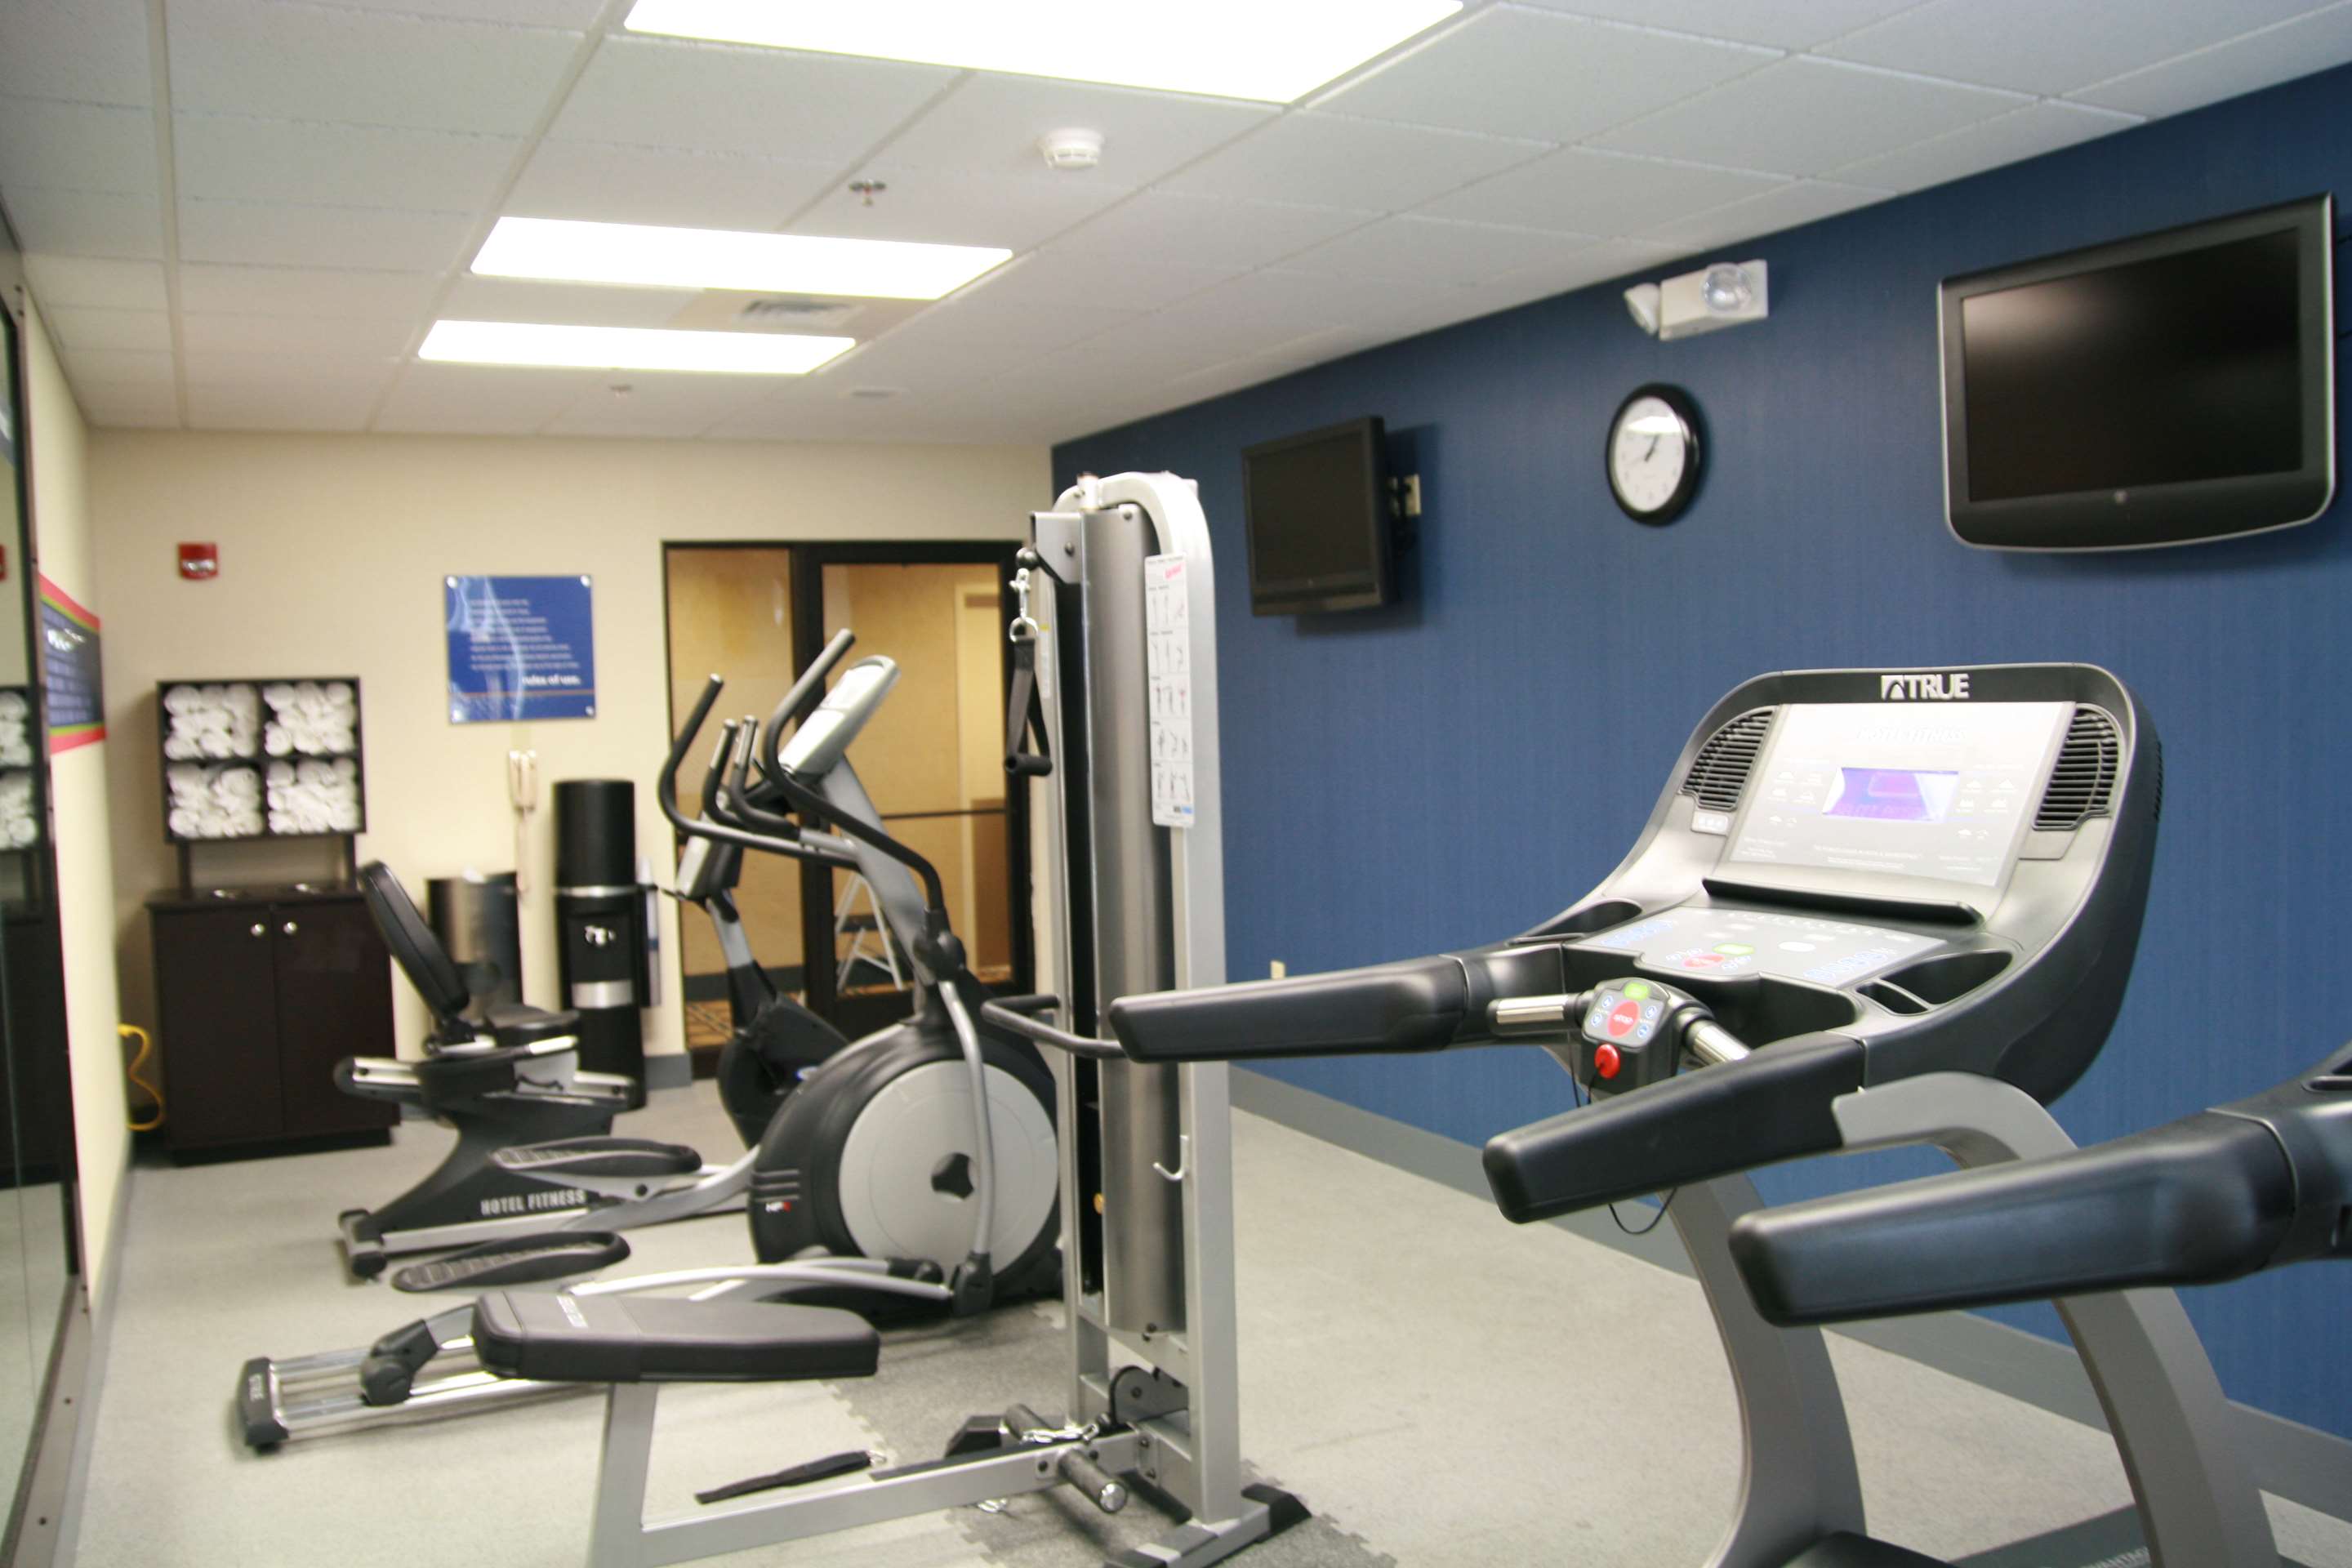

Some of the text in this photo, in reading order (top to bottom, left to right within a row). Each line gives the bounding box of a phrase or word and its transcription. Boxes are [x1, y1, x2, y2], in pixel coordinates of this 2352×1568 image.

[1904, 674, 1969, 700] TRUE
[481, 1189, 586, 1215] HOTEL FITNESS
